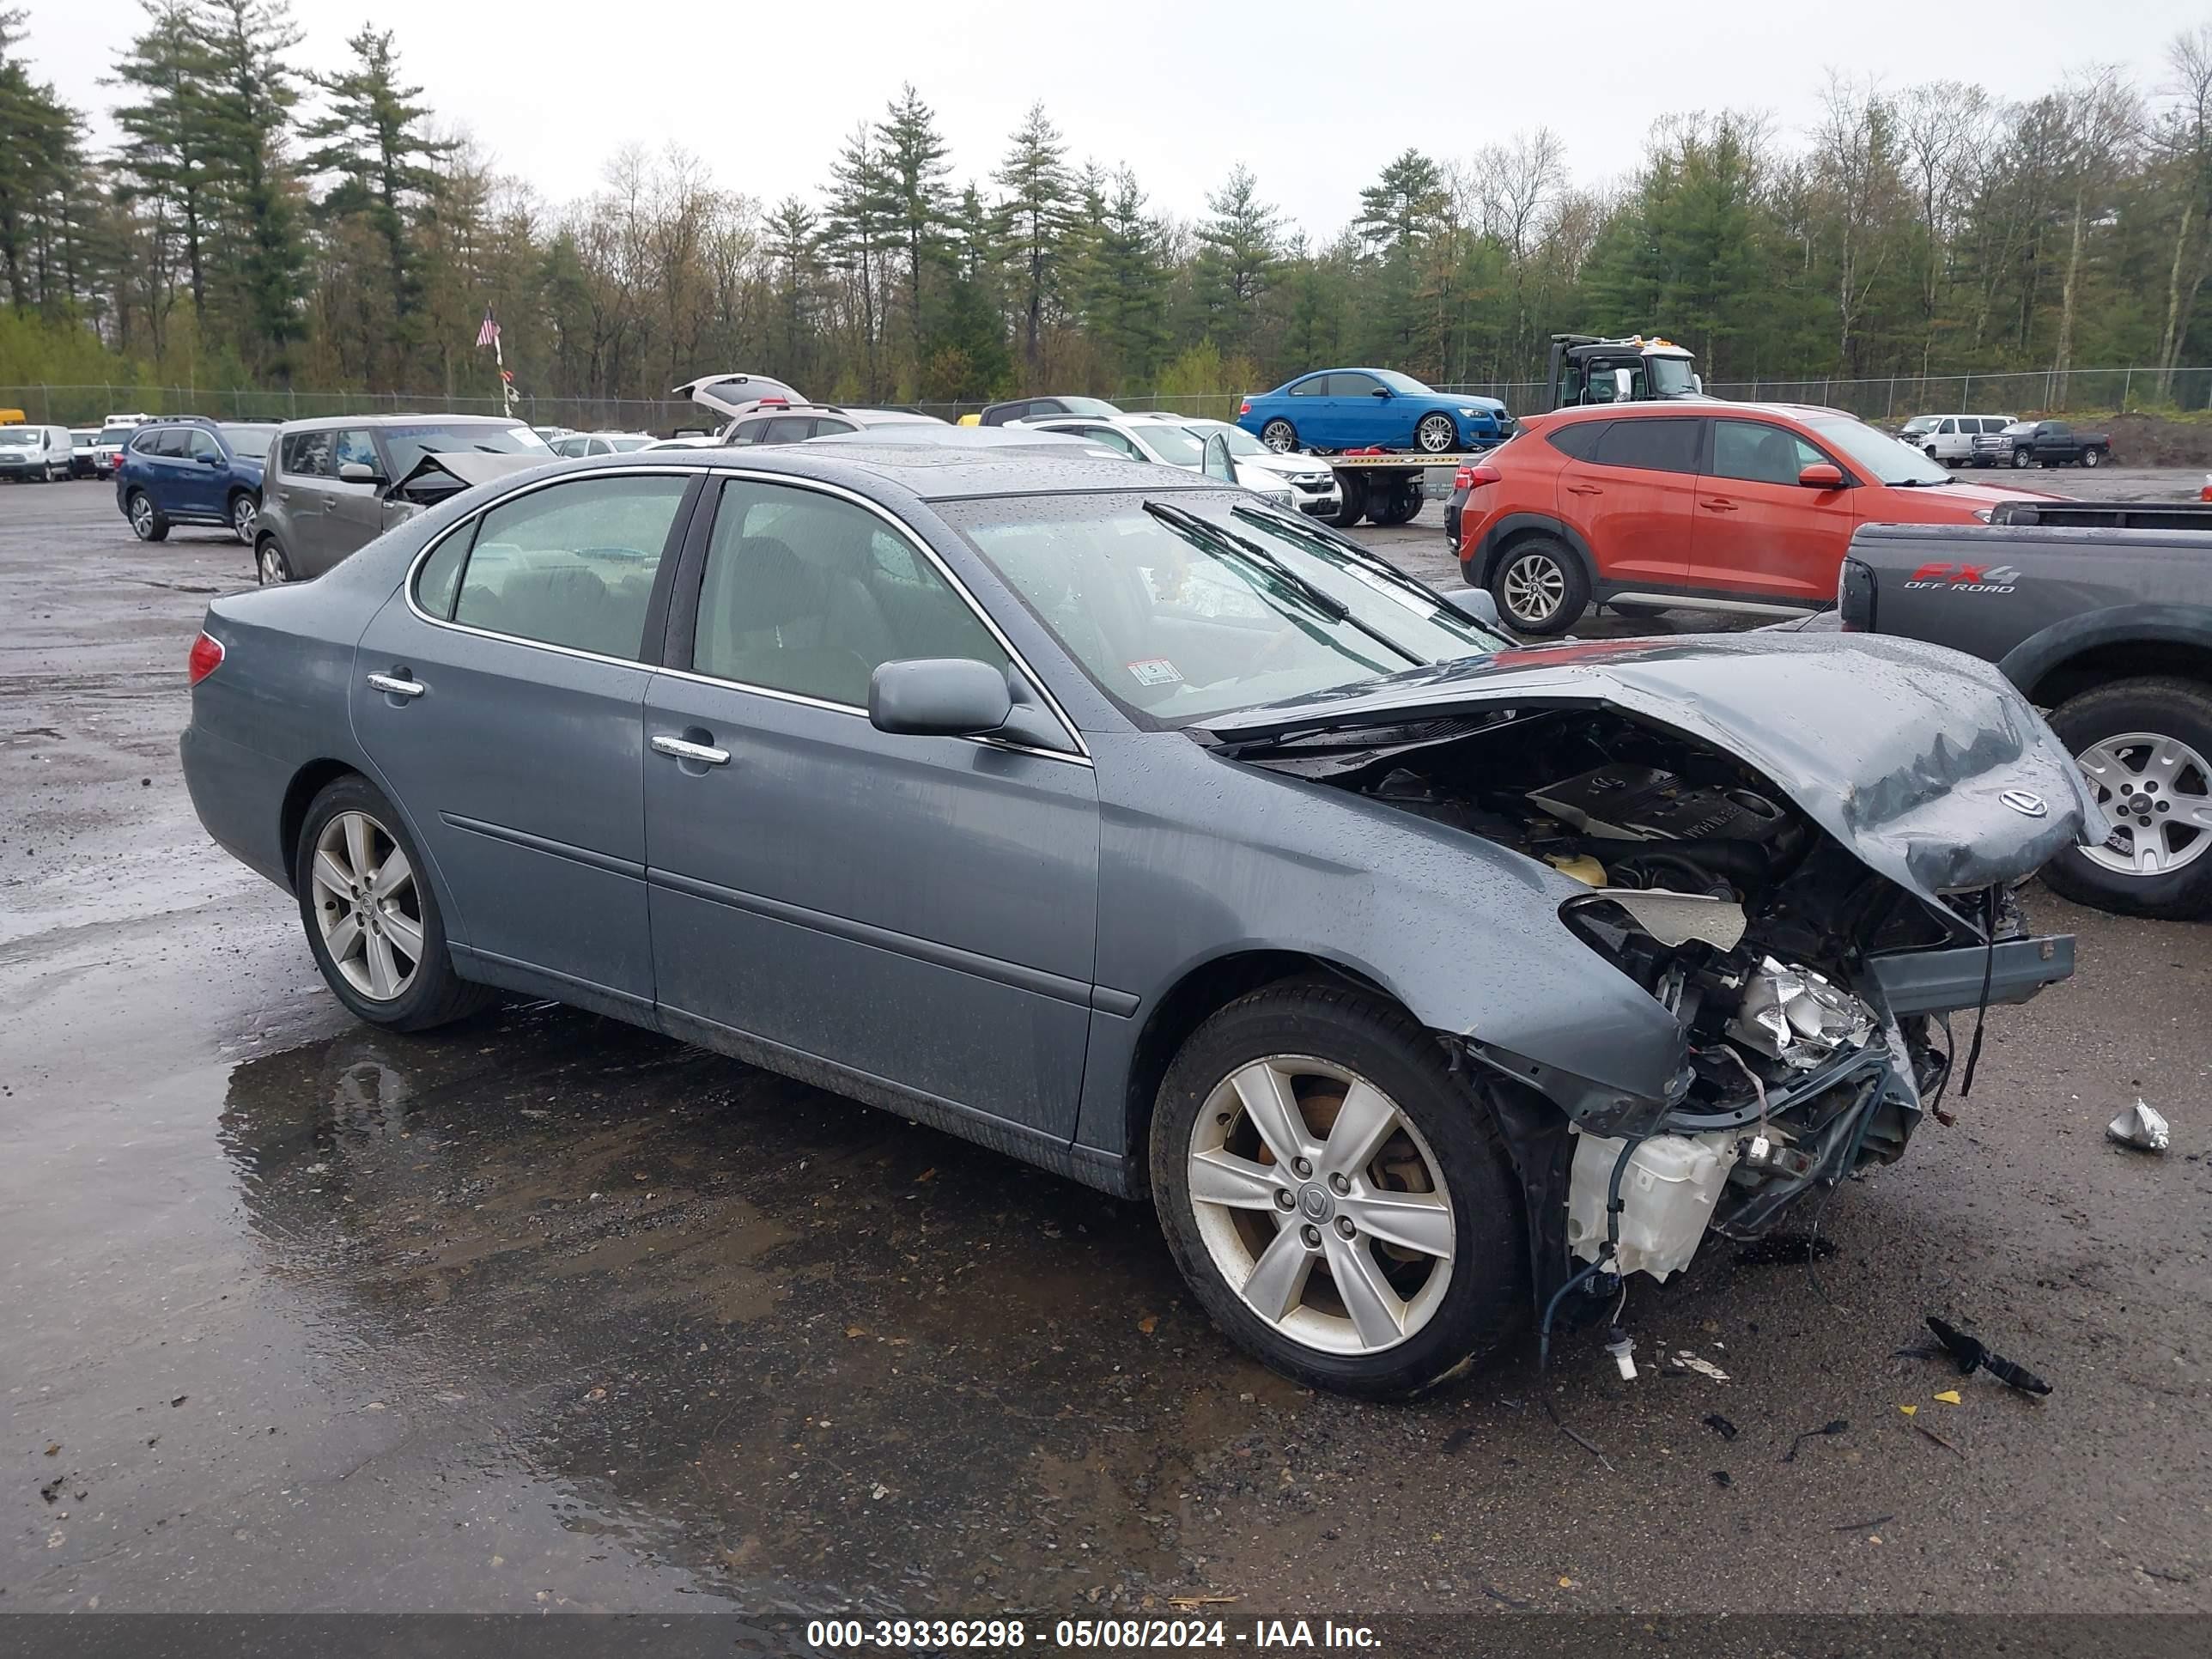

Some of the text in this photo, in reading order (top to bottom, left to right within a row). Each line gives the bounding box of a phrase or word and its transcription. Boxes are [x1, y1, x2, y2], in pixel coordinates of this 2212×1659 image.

[1911, 563, 2022, 584] FX4
[1904, 581, 2016, 593] OFF ROAD
